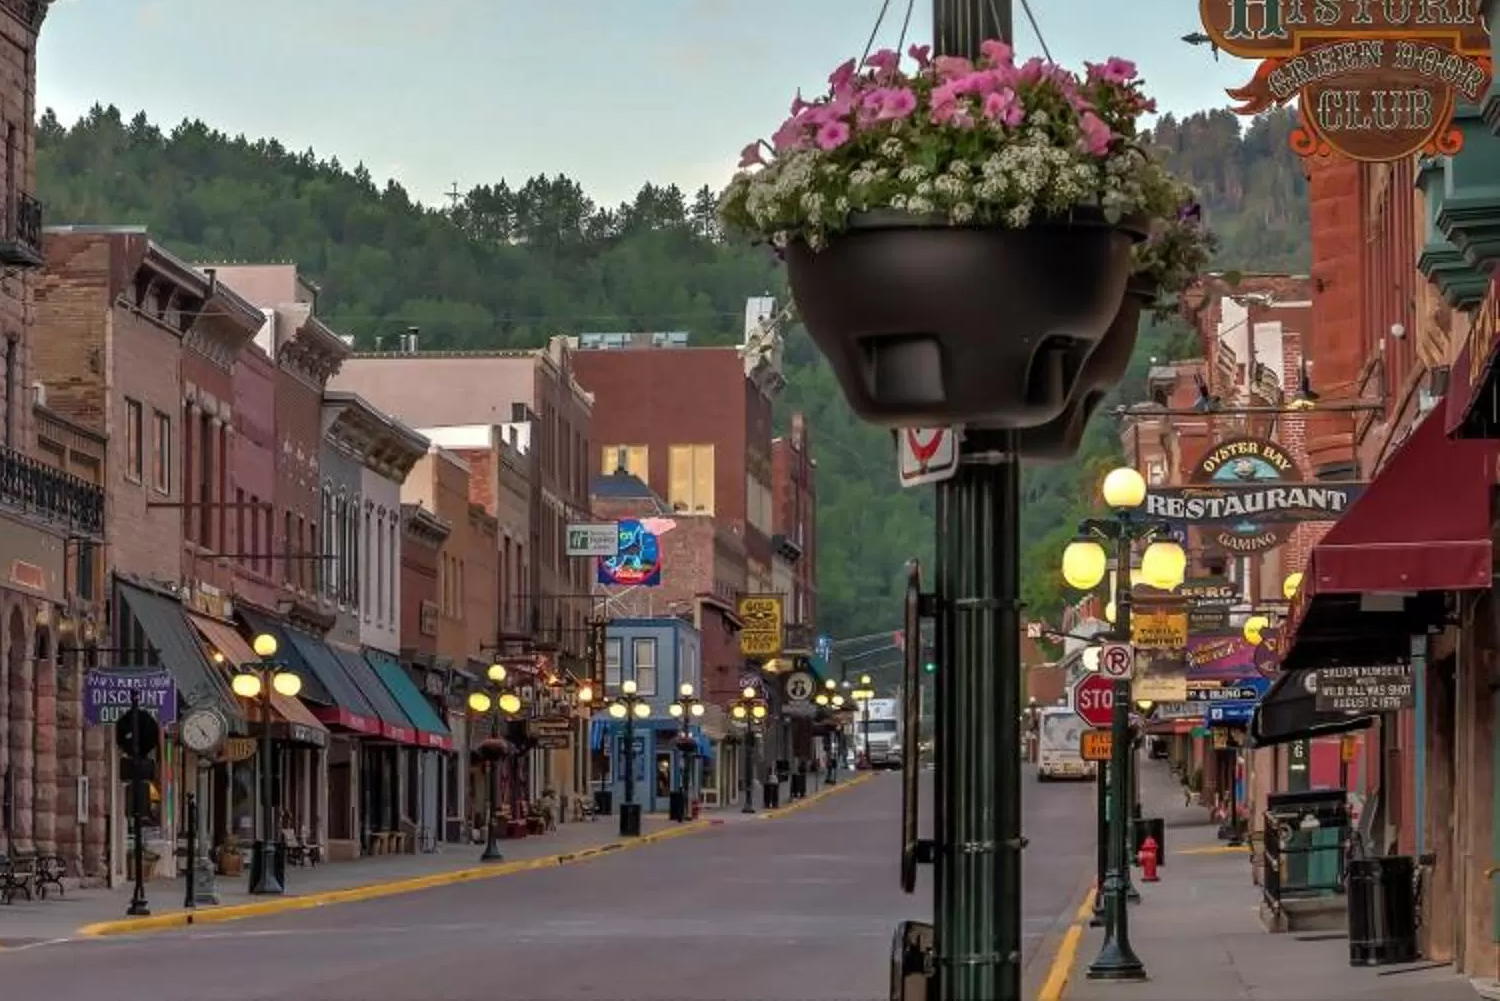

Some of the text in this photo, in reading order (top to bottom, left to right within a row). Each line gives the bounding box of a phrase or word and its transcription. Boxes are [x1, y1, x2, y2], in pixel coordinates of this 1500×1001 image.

[1268, 40, 1484, 98] GREEN DOOR
[1319, 90, 1432, 131] CLUB
[1203, 442, 1292, 472] OYSTER BAY
[1146, 488, 1347, 519] RESTAURANT
[1218, 533, 1277, 550] GAMING
[1080, 689, 1114, 709] STO
[1323, 684, 1411, 696] WILD BILL WAS SHOT
[100, 706, 159, 722] OUTT
